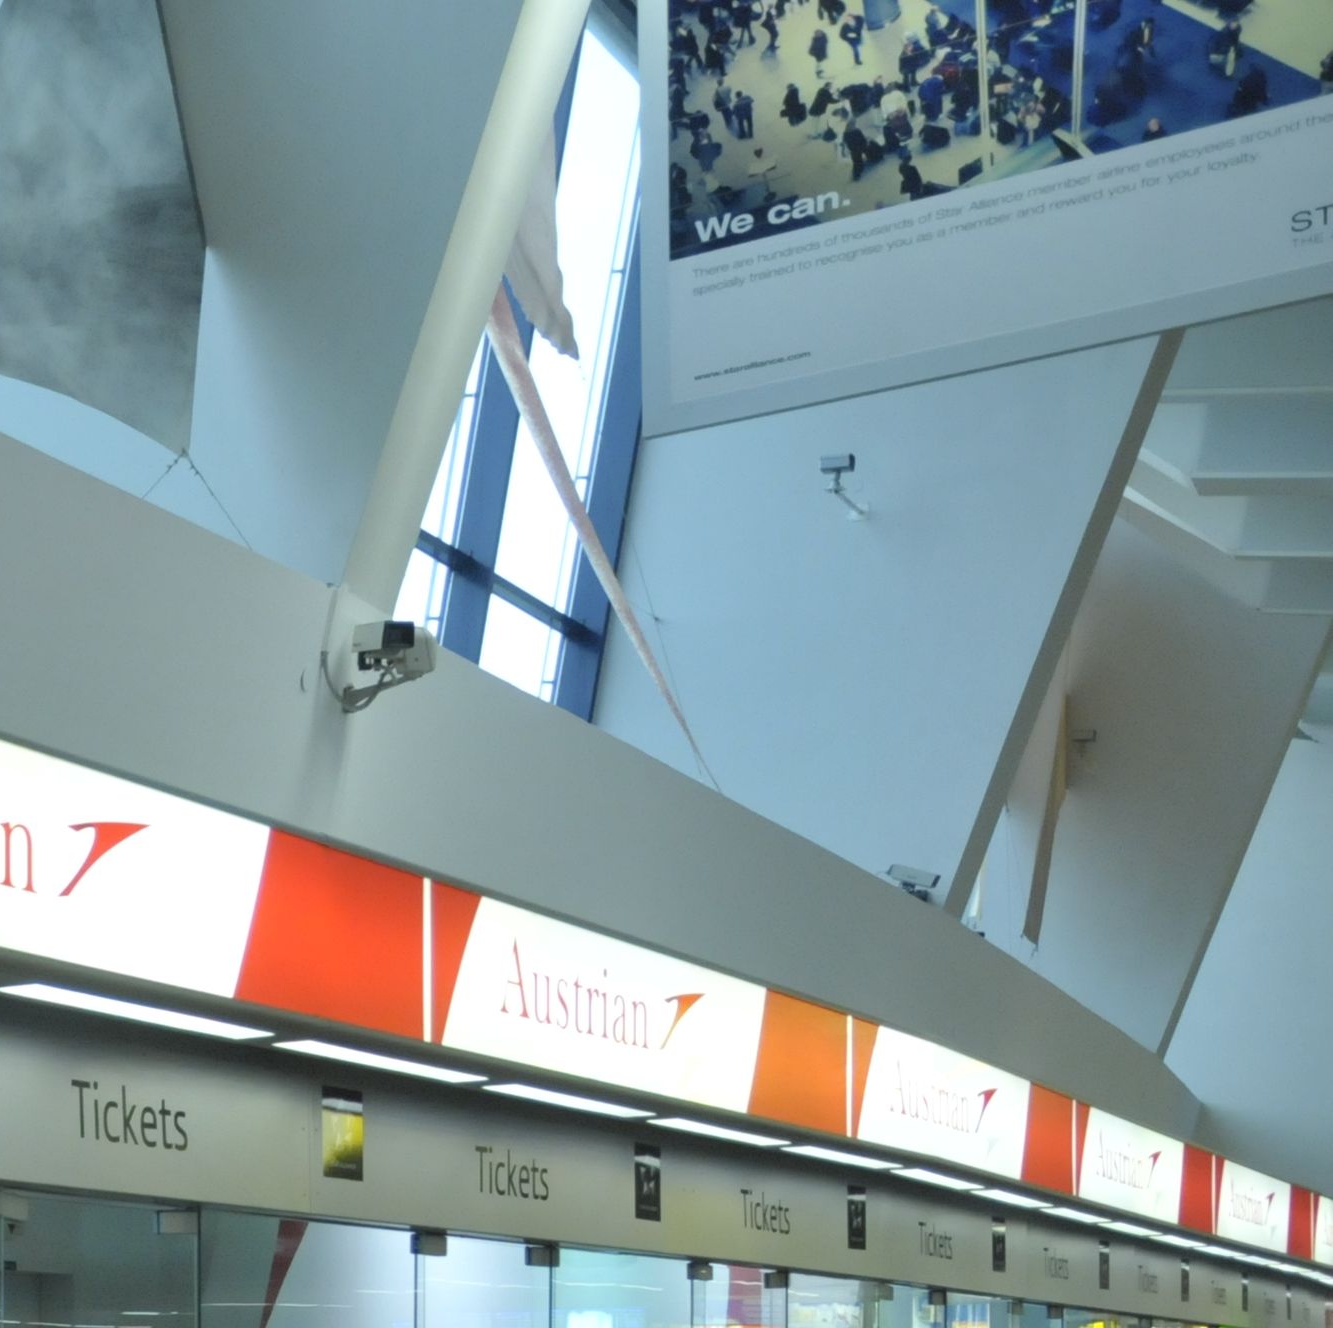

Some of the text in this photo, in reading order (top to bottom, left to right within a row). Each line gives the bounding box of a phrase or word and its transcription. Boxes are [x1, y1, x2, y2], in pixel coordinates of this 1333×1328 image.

[692, 261, 730, 279] There
[732, 256, 755, 268] are
[757, 239, 821, 264] hundreds
[823, 234, 840, 247] of
[841, 217, 915, 243] thousands
[917, 211, 933, 226] of
[935, 205, 964, 221] Star
[969, 190, 1024, 213] Alliance
[1027, 172, 1092, 198] member
[1097, 161, 1141, 181] airline
[1145, 137, 1237, 168] employees
[1240, 118, 1302, 144] around
[692, 274, 747, 297] specially
[749, 262, 795, 283] trained
[797, 259, 813, 272] to
[816, 243, 885, 268] recognise
[886, 234, 914, 253] you
[916, 230, 934, 243] as
[937, 227, 947, 238] a
[949, 211, 1013, 236] member
[1016, 199, 1046, 217] and
[1049, 188, 1104, 211] reward
[1107, 181, 1138, 200] you
[1141, 174, 1162, 190] for
[1166, 165, 1202, 186] your
[694, 190, 852, 243] We can.
[499, 935, 650, 1051] Austrian
[71, 1079, 189, 1152] Tickets
[889, 1058, 971, 1135] Austrian
[475, 1146, 551, 1202] Tickets
[1096, 1128, 1145, 1190] Austrian
[740, 1189, 792, 1237] Tickets
[917, 1221, 954, 1262] Tickets
